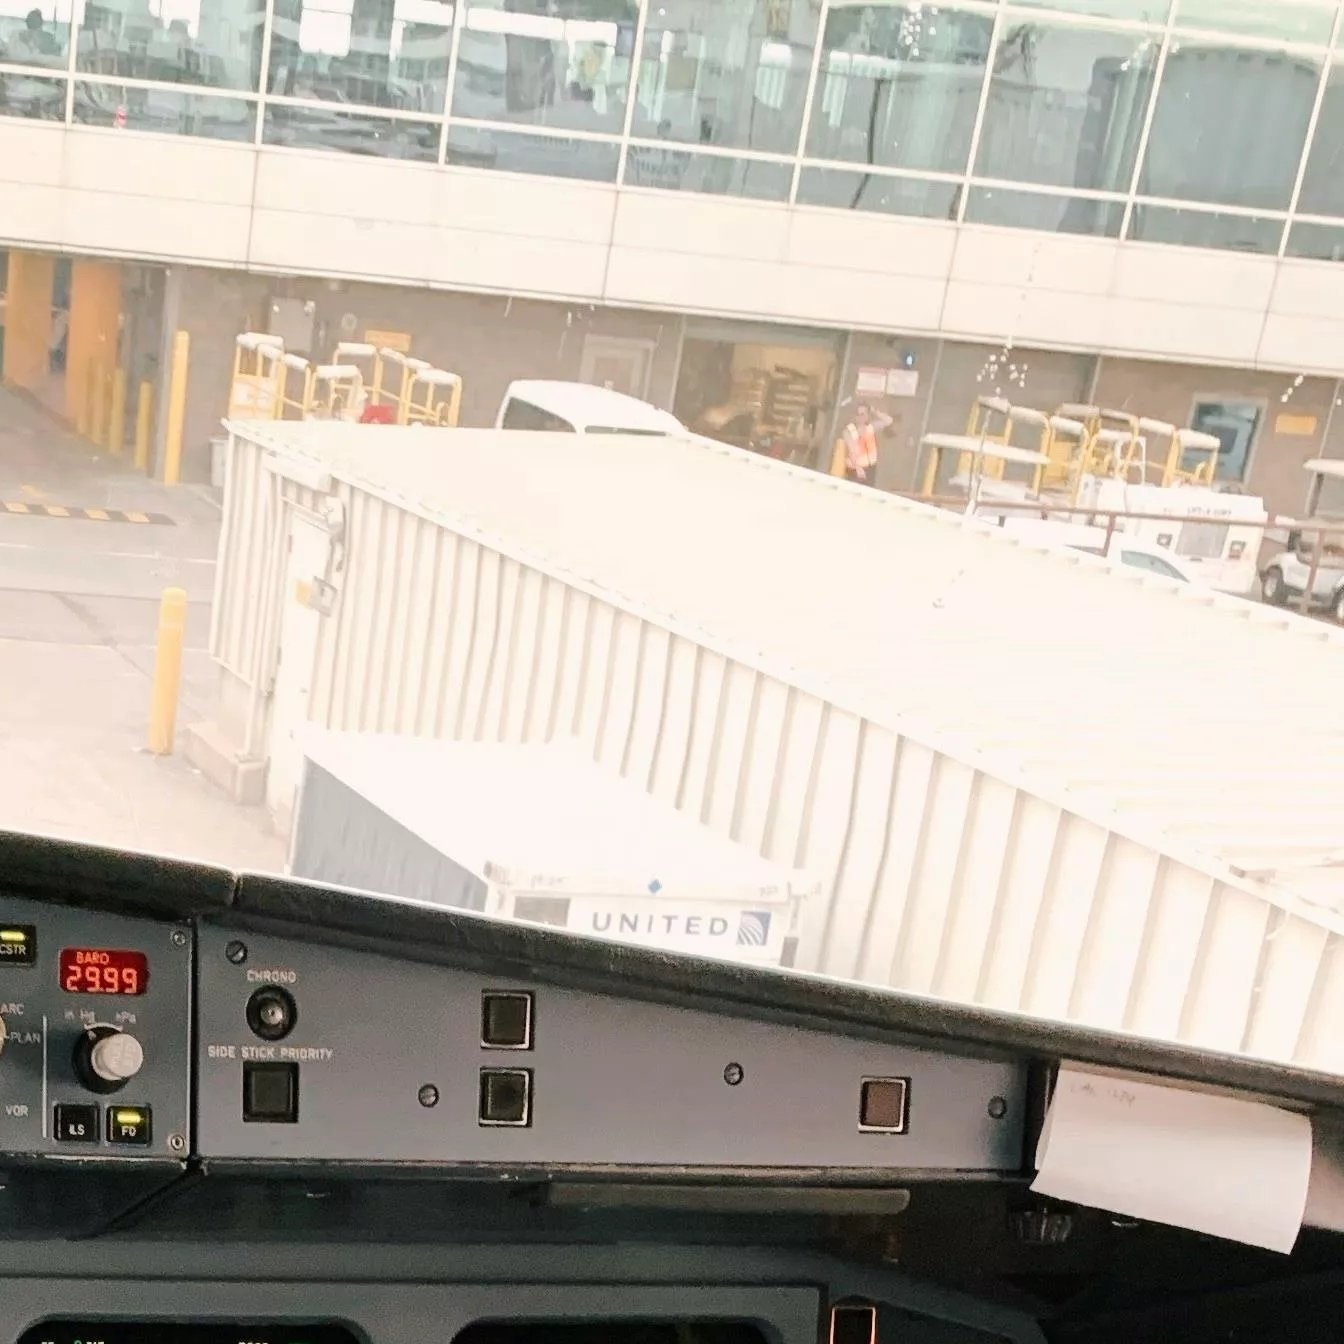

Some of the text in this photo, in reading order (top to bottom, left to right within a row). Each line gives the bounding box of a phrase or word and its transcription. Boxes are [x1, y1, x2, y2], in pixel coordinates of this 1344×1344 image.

[591, 911, 730, 938] UNITED
[76, 951, 110, 965] BARO
[66, 967, 138, 994] 29.99
[246, 970, 296, 984] CHRONO
[208, 1045, 333, 1061] SIDE STICK PRIORITY
